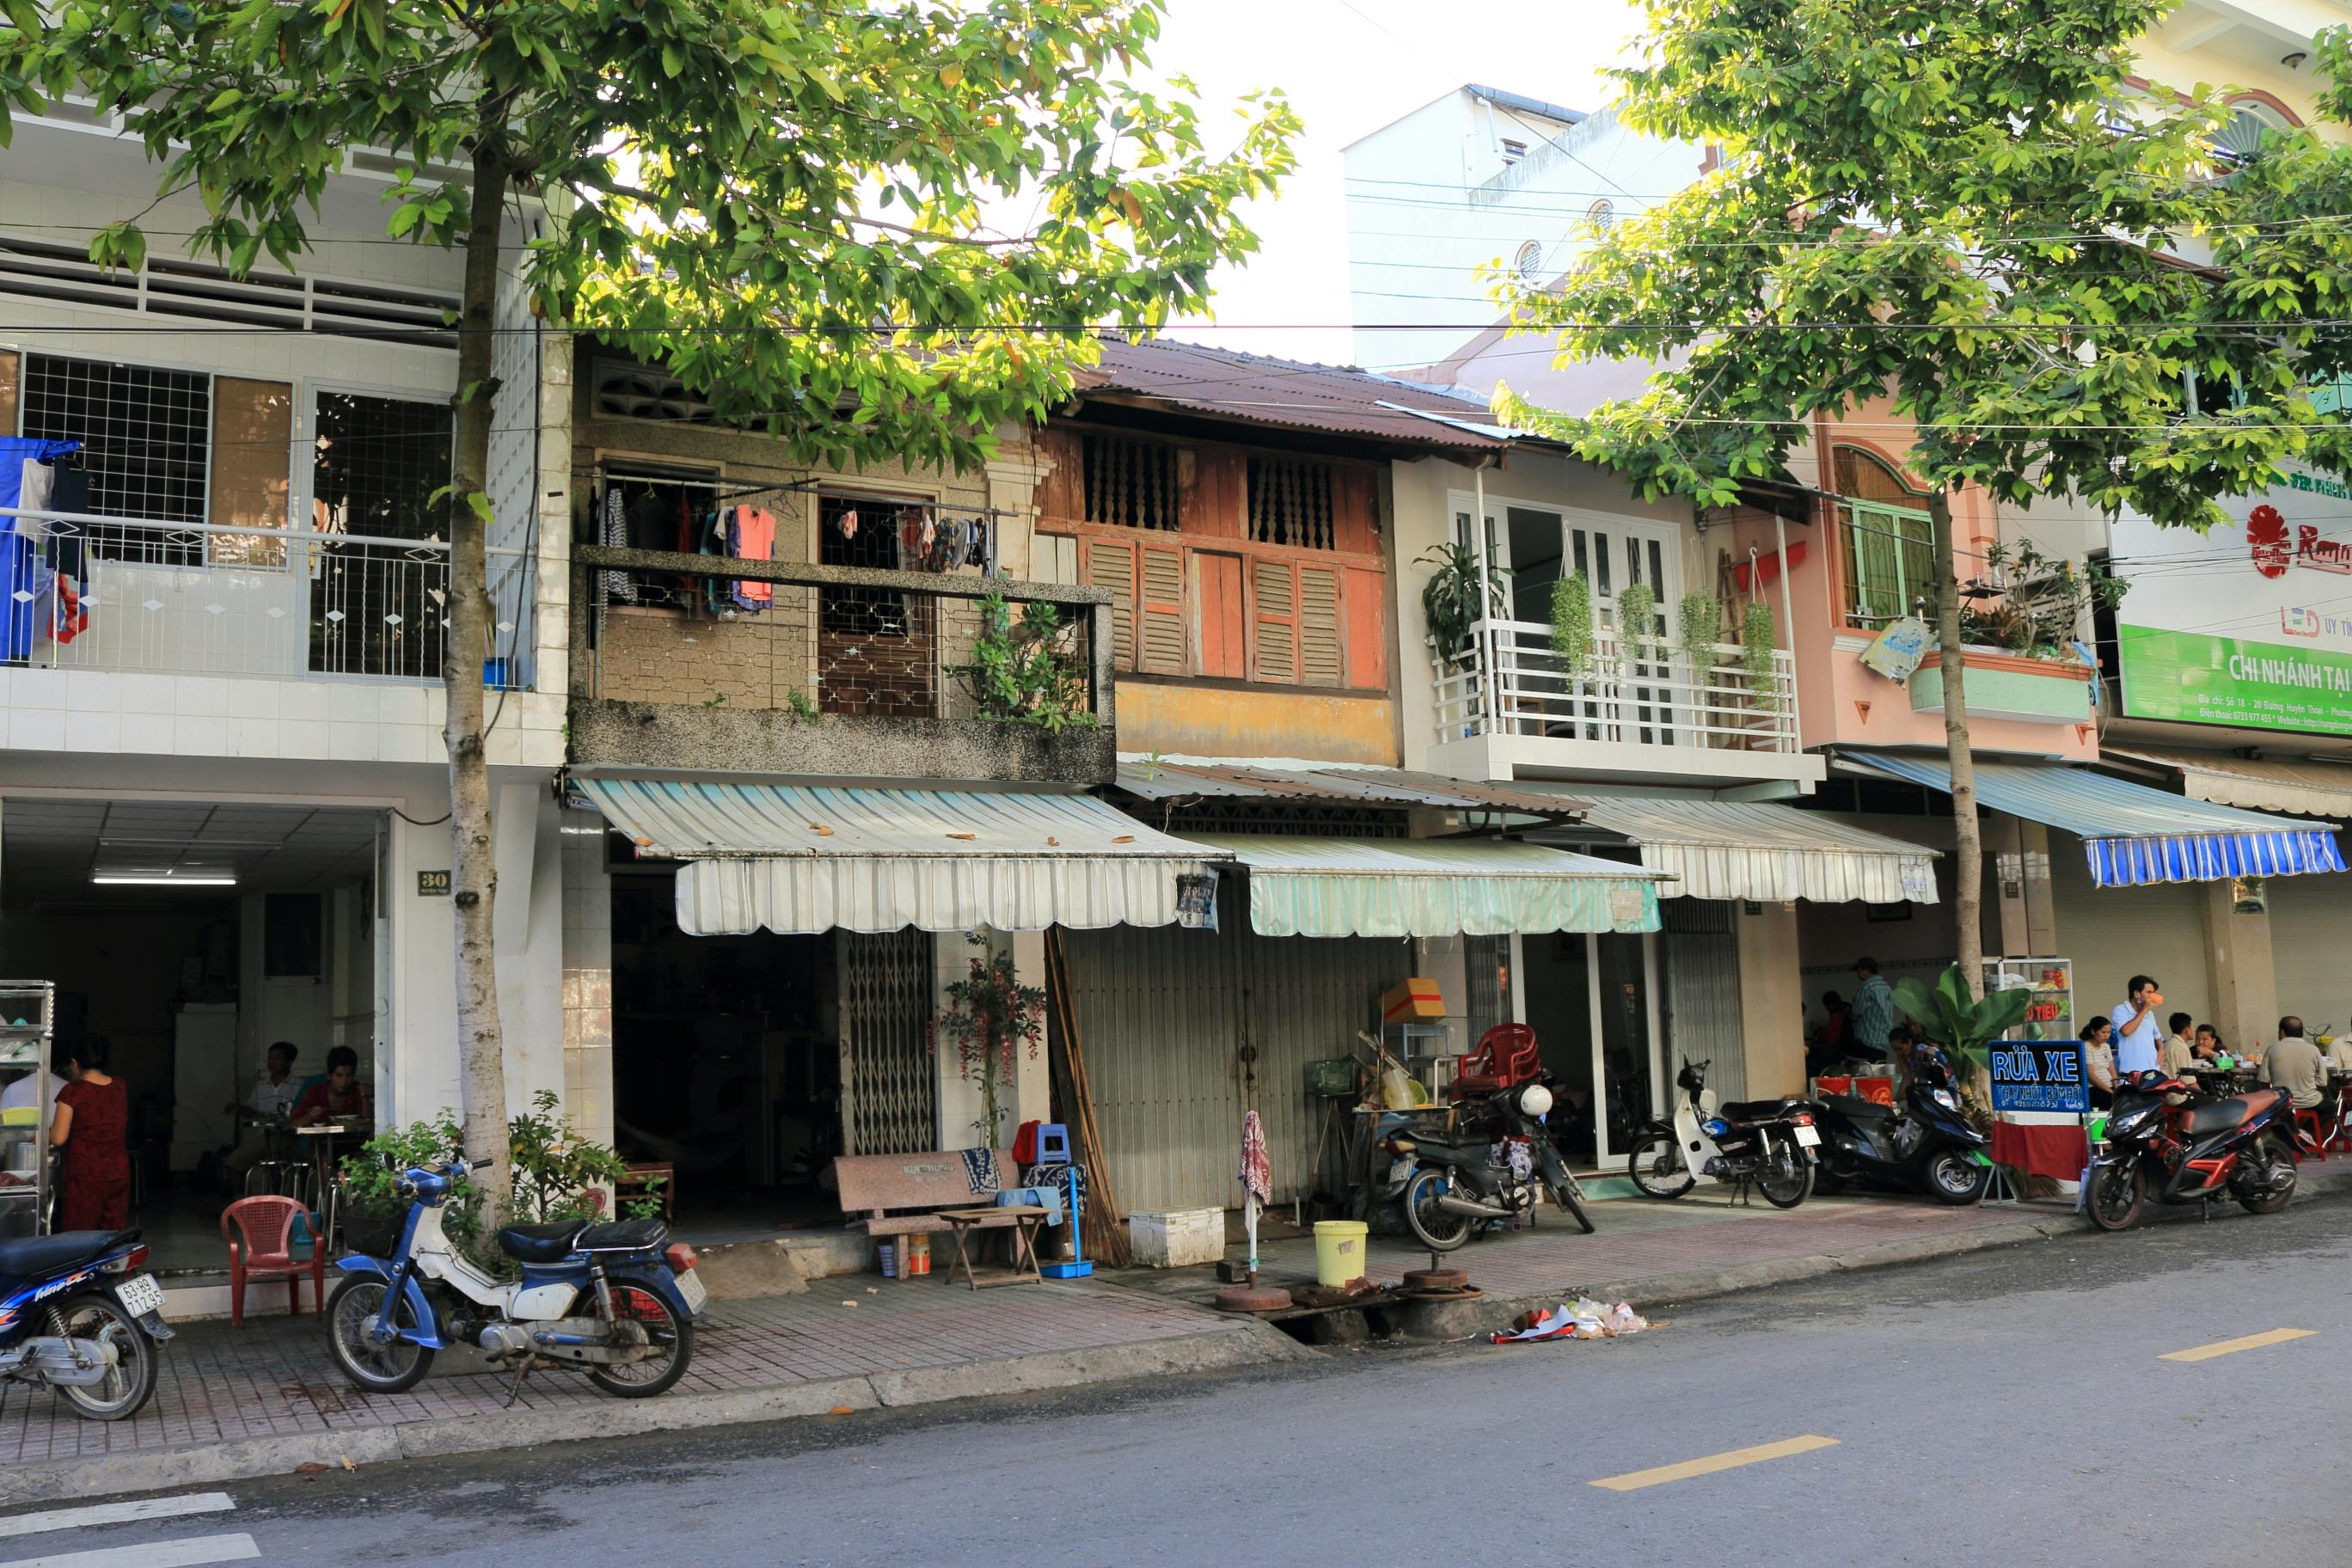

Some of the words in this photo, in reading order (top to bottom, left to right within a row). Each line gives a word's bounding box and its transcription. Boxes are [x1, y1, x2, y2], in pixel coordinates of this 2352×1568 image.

[2229, 654, 2258, 682] CHI
[2261, 656, 2322, 689] NHÁNH
[2323, 665, 2350, 698] TẠI
[422, 873, 447, 887] 30
[1992, 1044, 2040, 1081] RỬA
[2043, 1050, 2079, 1081] XE
